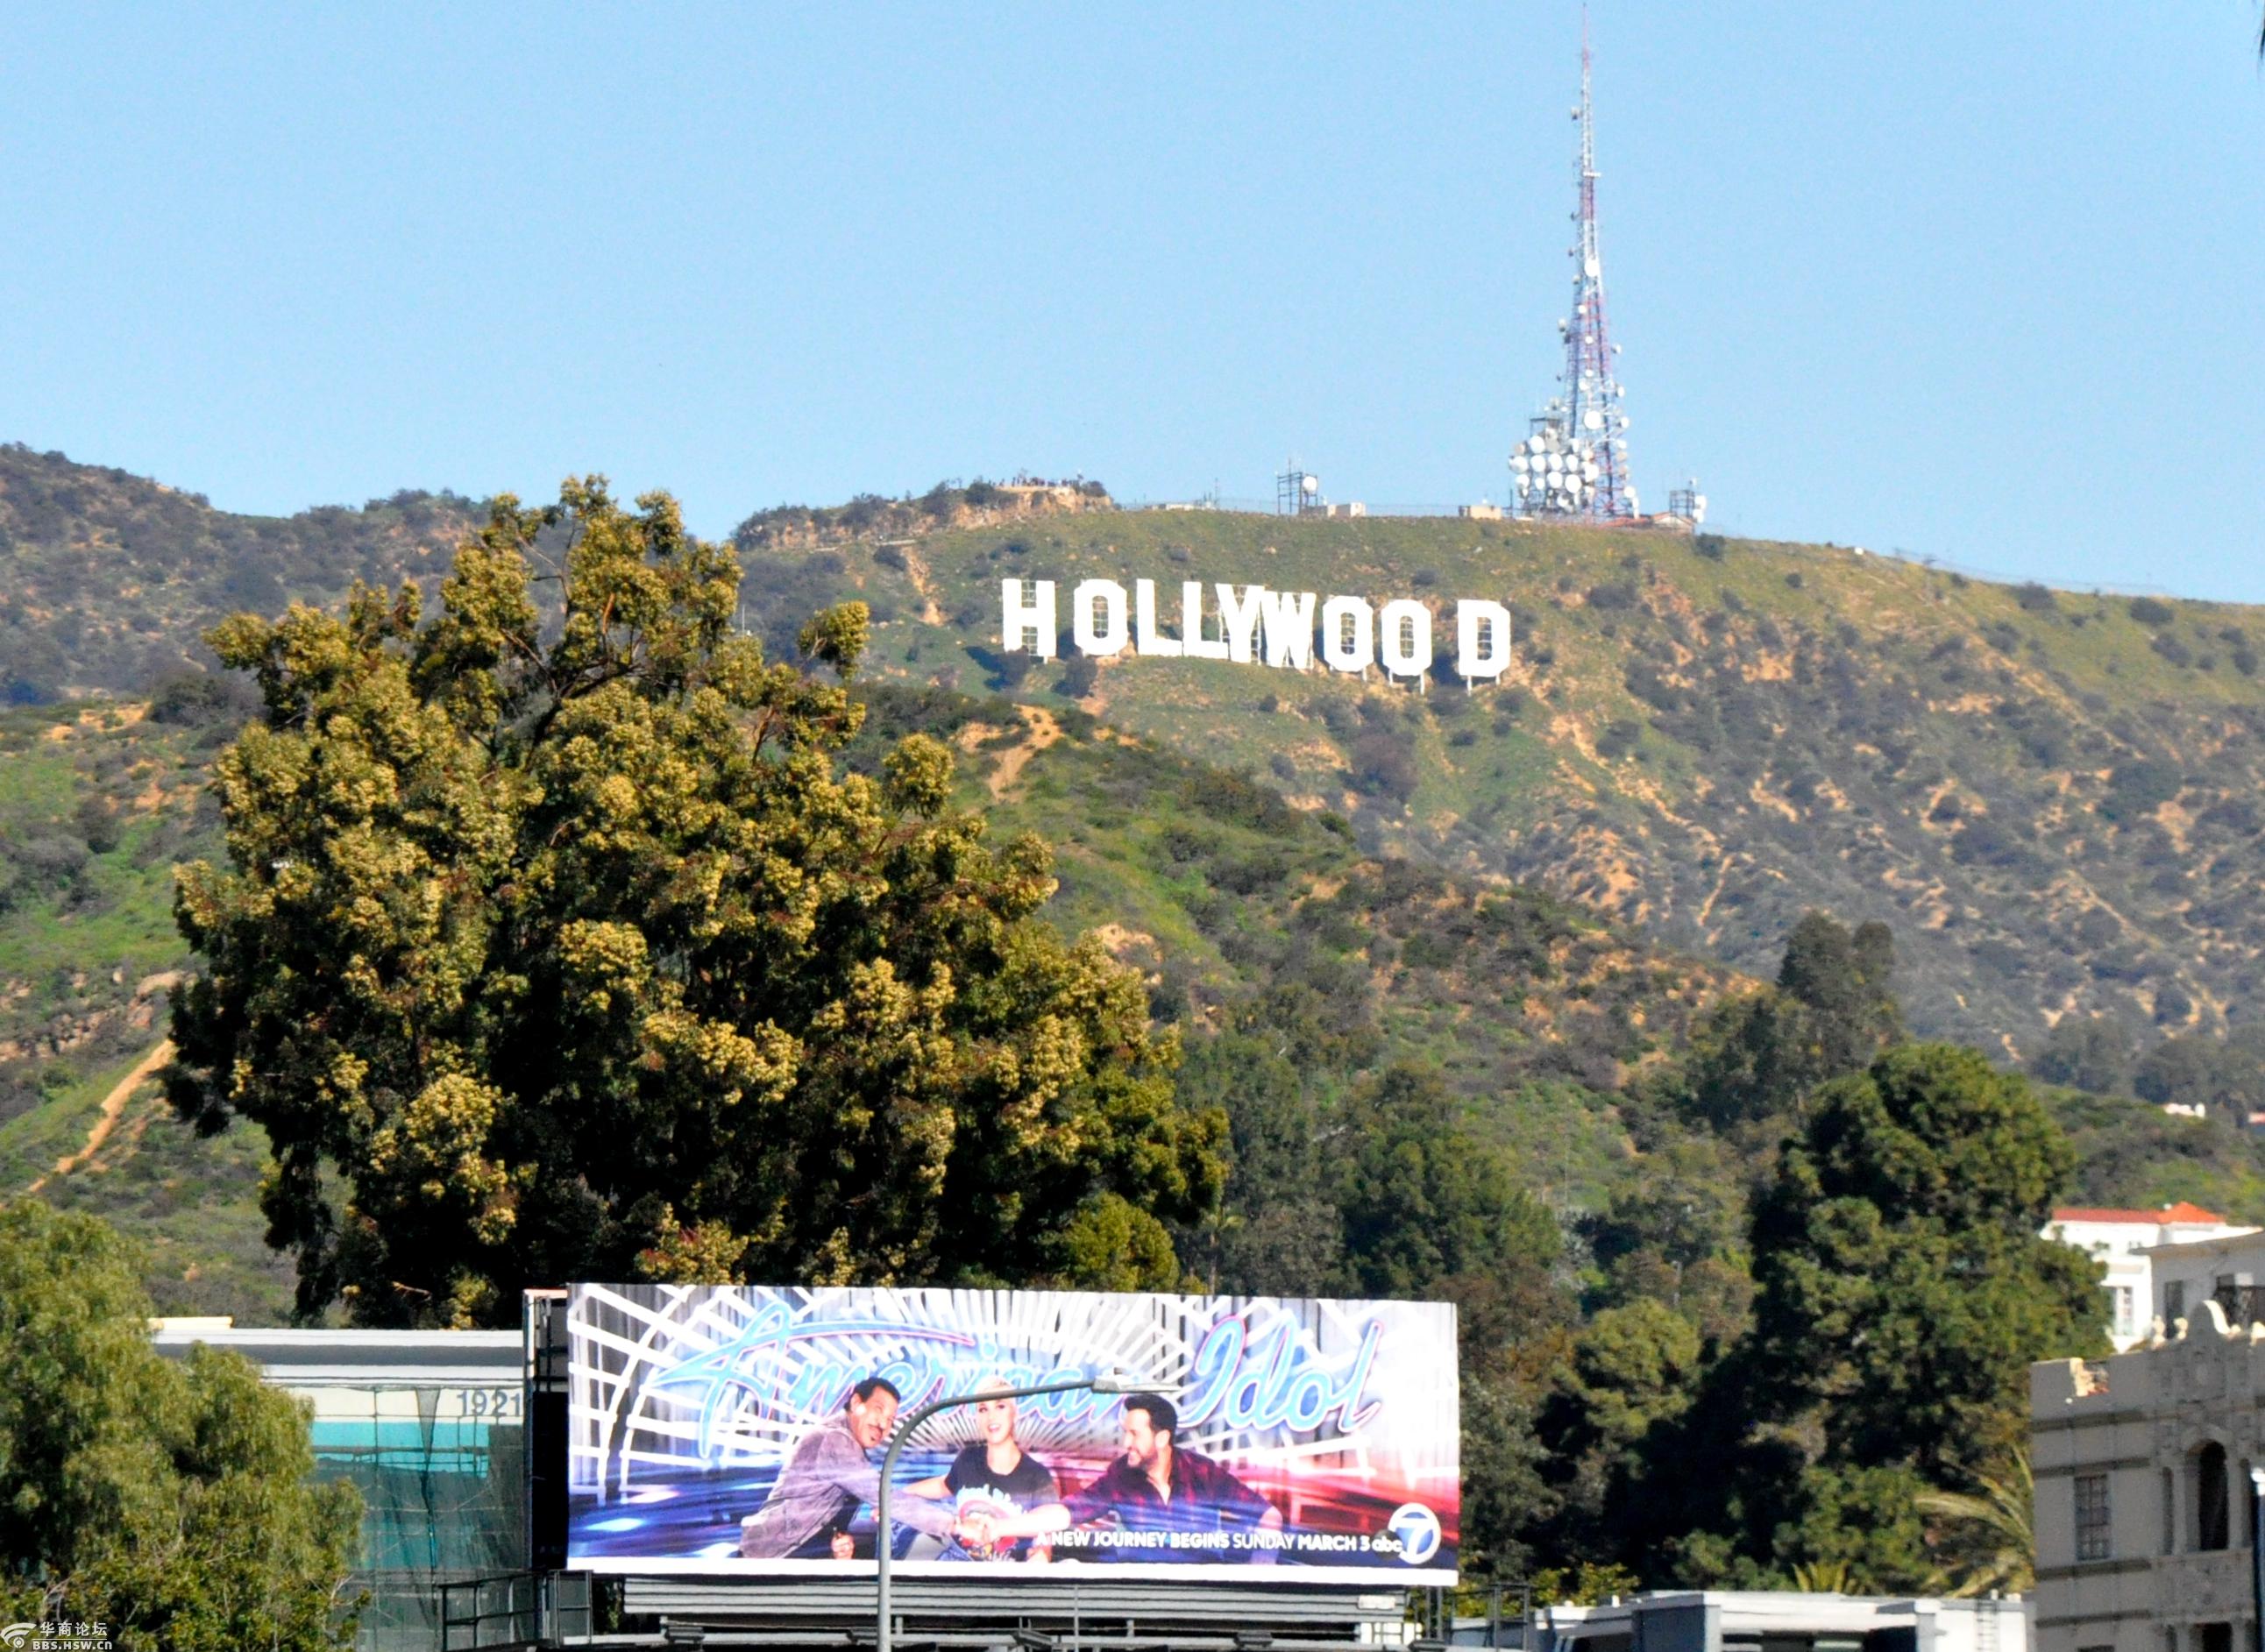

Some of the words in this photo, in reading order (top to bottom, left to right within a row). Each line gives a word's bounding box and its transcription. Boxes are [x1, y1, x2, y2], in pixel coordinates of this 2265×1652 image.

[1002, 578, 1511, 677] HOLLYWOOD
[1177, 1313, 1385, 1432] Idol
[457, 1388, 521, 1417] 1921
[1035, 1532, 1048, 1546] A
[1052, 1532, 1091, 1547] NEW
[1093, 1532, 1168, 1548] JOURNEY
[1170, 1533, 1229, 1549] BEGINS
[1232, 1534, 1294, 1549] SUNDAY
[1297, 1535, 1357, 1551] MARCH
[1372, 1535, 1402, 1552] abc
